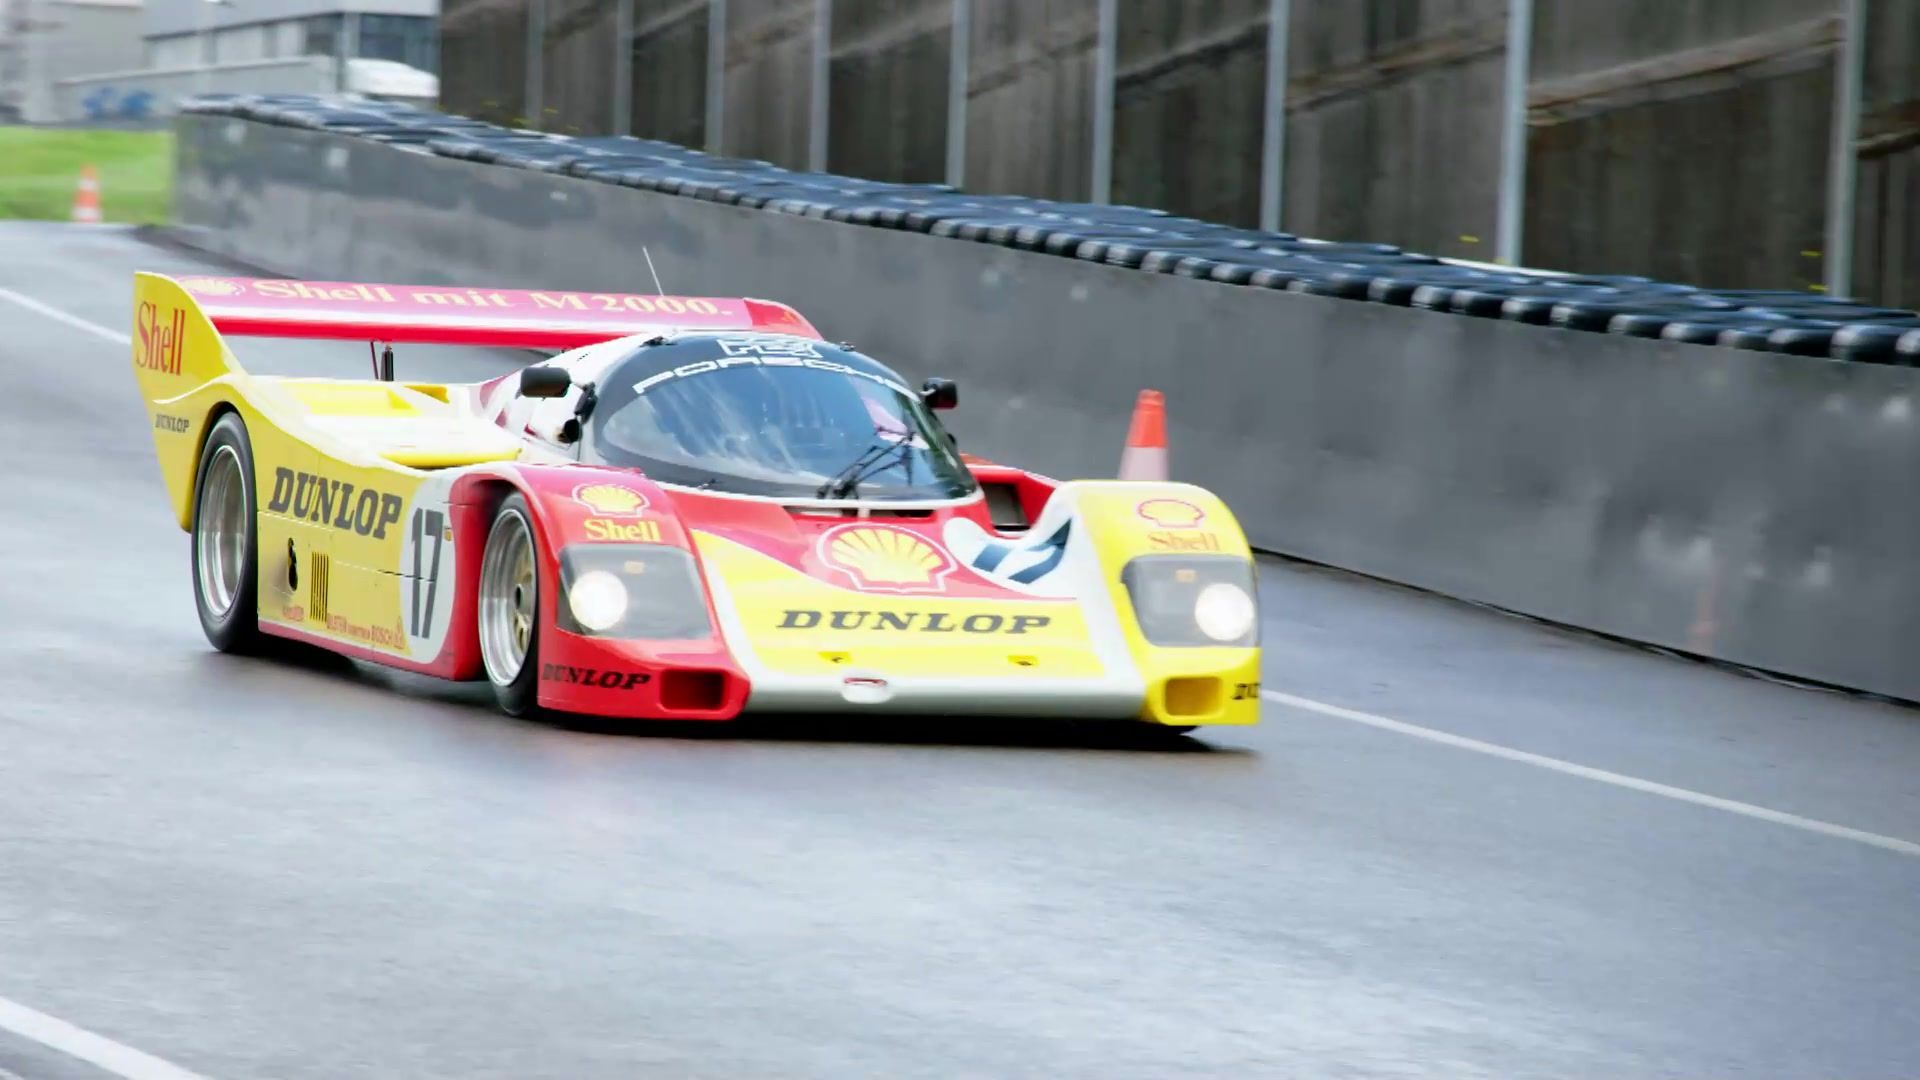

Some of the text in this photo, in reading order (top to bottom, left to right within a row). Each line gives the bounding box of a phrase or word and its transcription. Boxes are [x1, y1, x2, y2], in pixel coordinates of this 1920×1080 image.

[251, 280, 397, 303] Shell
[410, 288, 511, 309] mit
[135, 301, 186, 376] Shell
[155, 413, 190, 434] DUNLOP
[268, 466, 403, 540] DUNLOP
[583, 518, 662, 543] Shell
[1147, 530, 1222, 552] Shell
[411, 507, 445, 640] 17
[776, 610, 1051, 634] DUNLOP
[541, 663, 652, 691] DUNLOP
